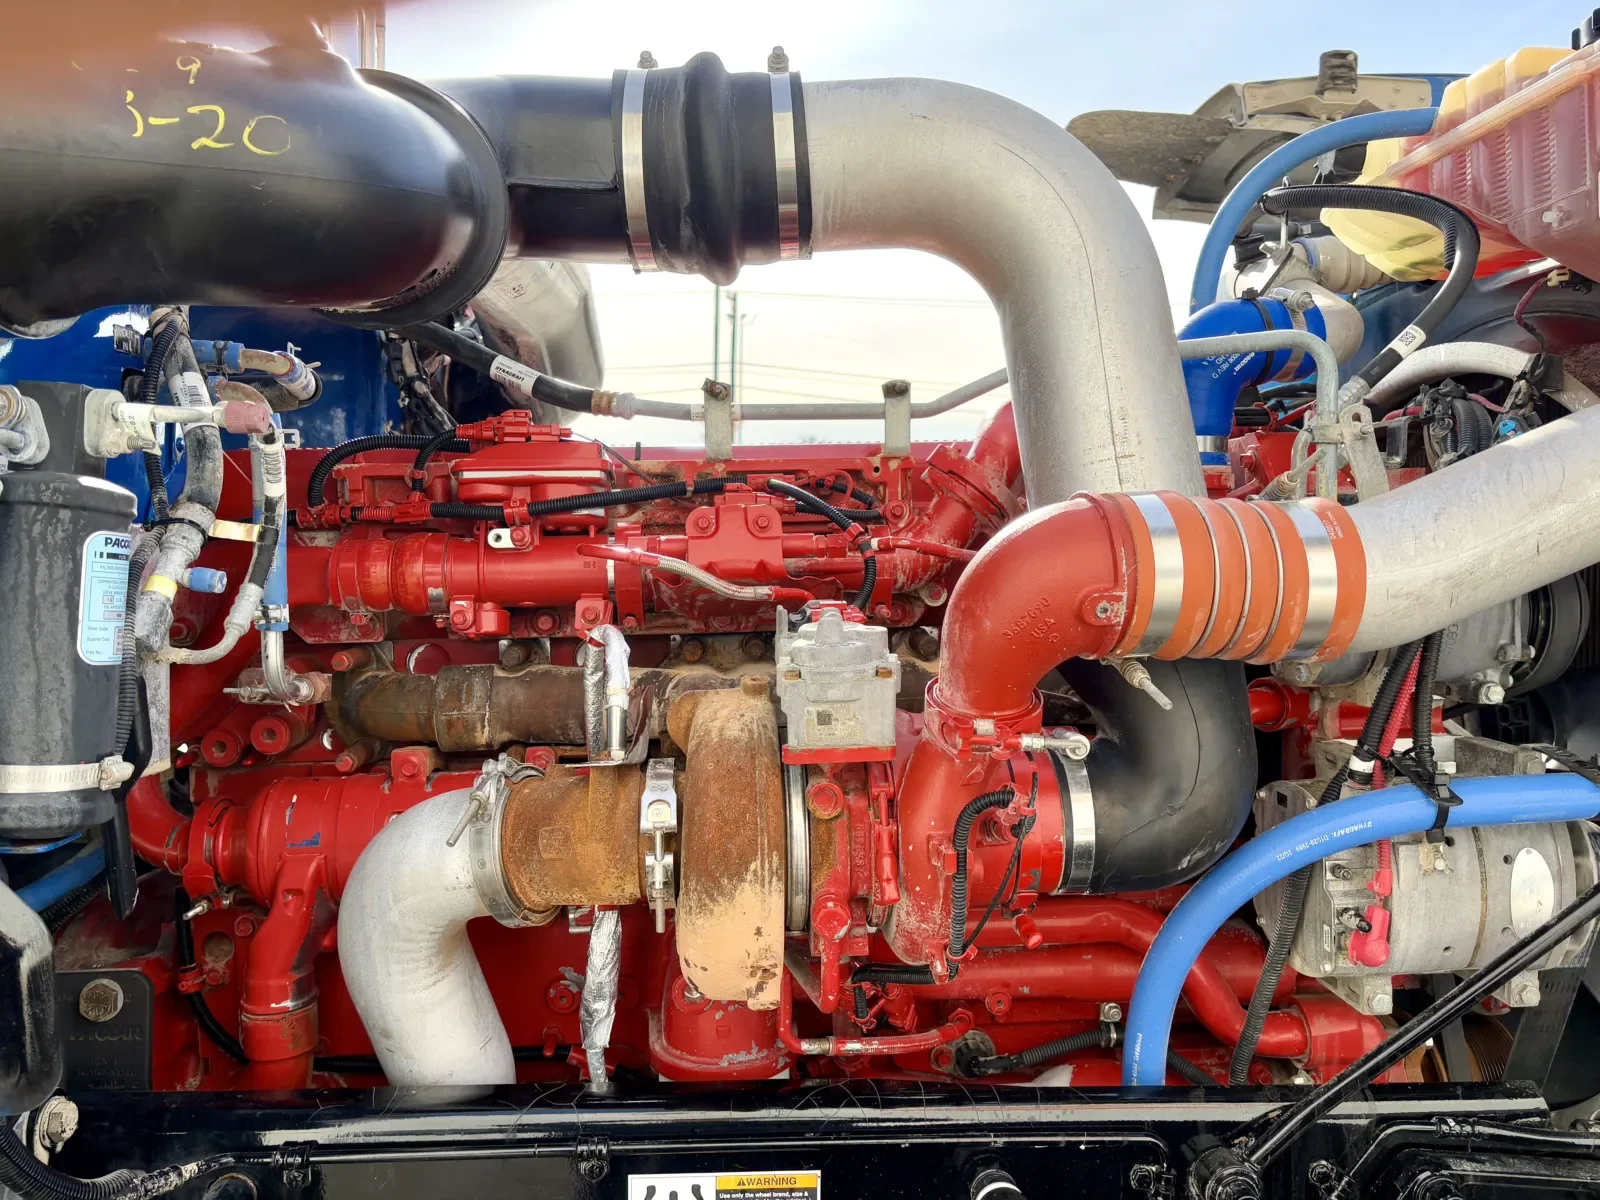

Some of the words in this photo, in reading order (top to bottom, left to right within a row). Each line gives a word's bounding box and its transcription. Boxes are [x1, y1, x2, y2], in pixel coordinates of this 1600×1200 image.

[104, 536, 130, 549] PACC
[1030, 617, 1057, 639] USA
[746, 1176, 797, 1186] WARNING
